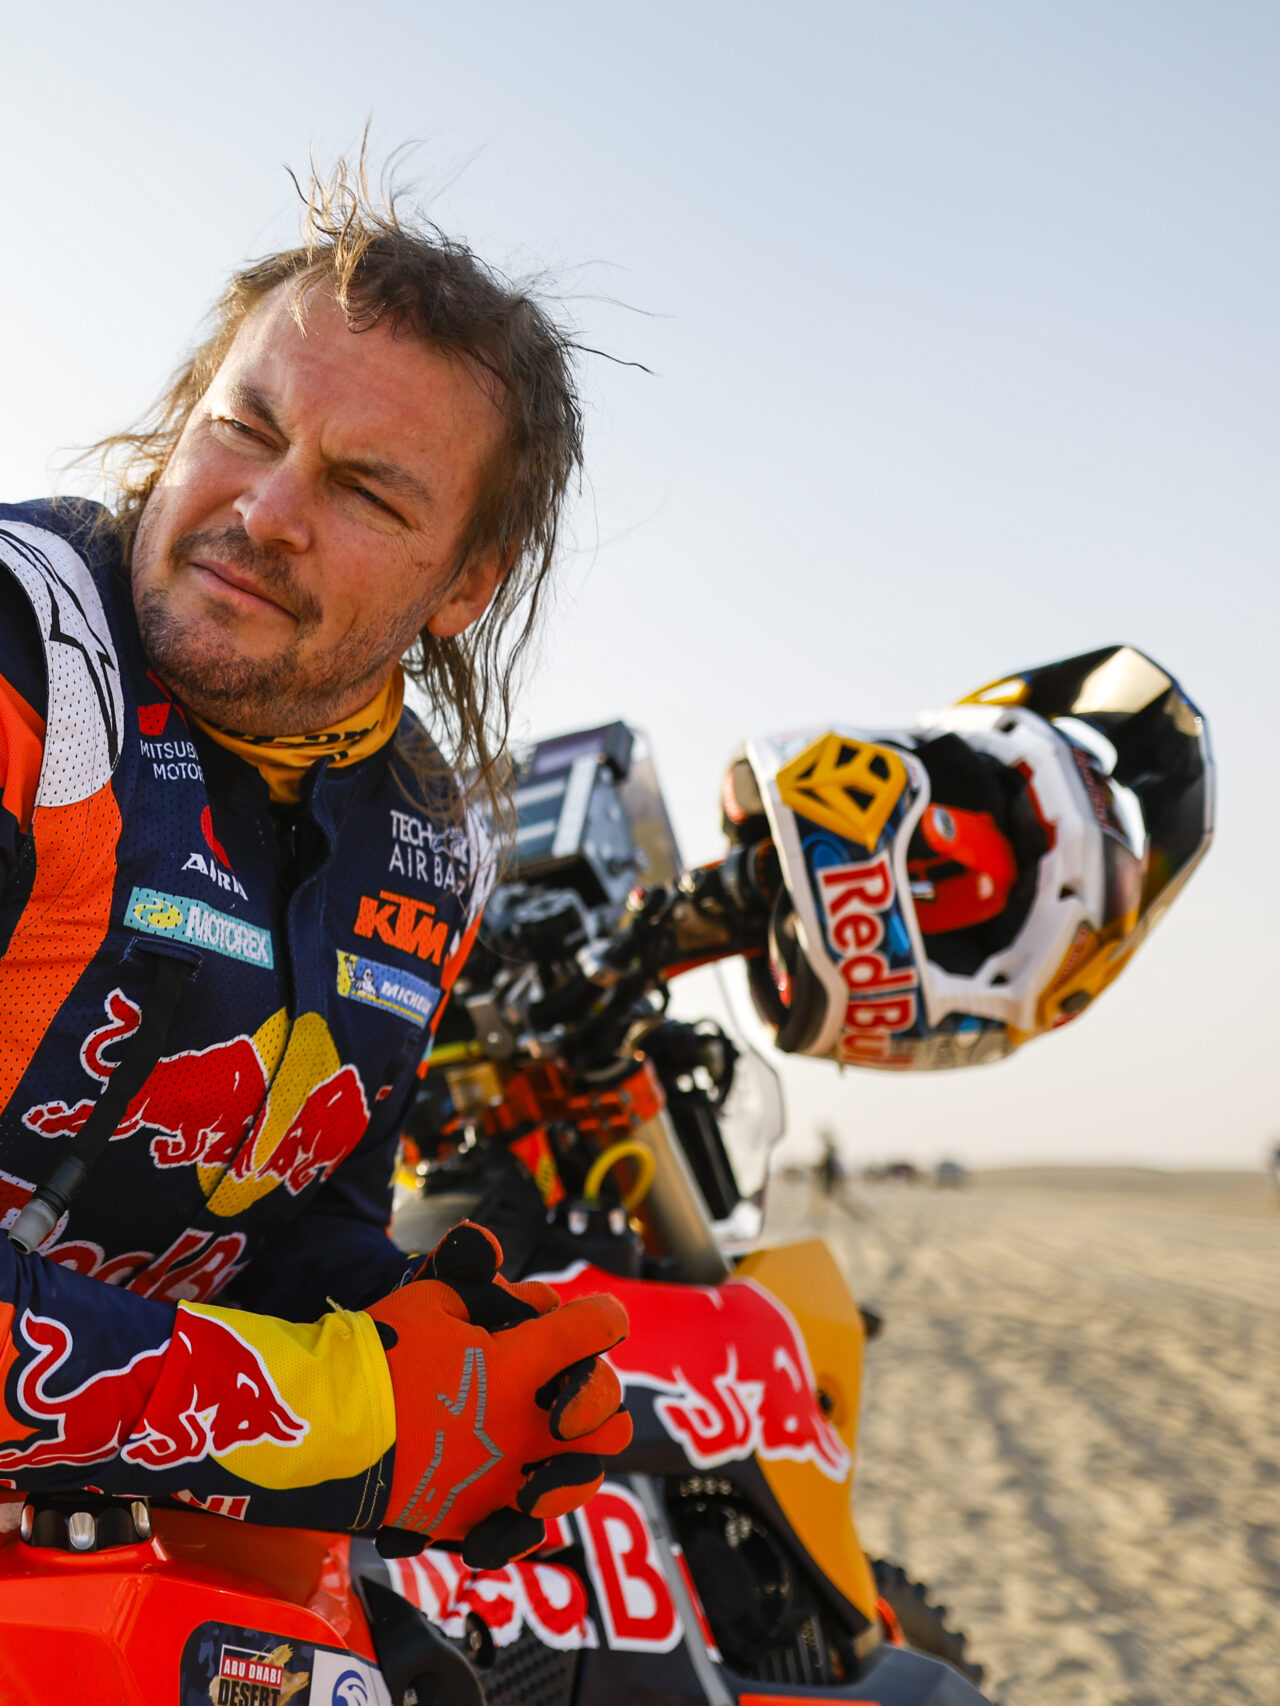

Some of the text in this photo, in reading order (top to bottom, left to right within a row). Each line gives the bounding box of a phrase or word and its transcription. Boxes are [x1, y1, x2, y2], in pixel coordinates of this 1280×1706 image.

[140, 740, 200, 761] MITSUB
[389, 843, 429, 882] AIR
[185, 906, 270, 963] MOTOREX
[354, 890, 449, 966] KTM
[381, 981, 433, 1016] MICHE
[223, 1658, 282, 1685] ABU DHABI
[219, 1678, 281, 1706] DESERT
